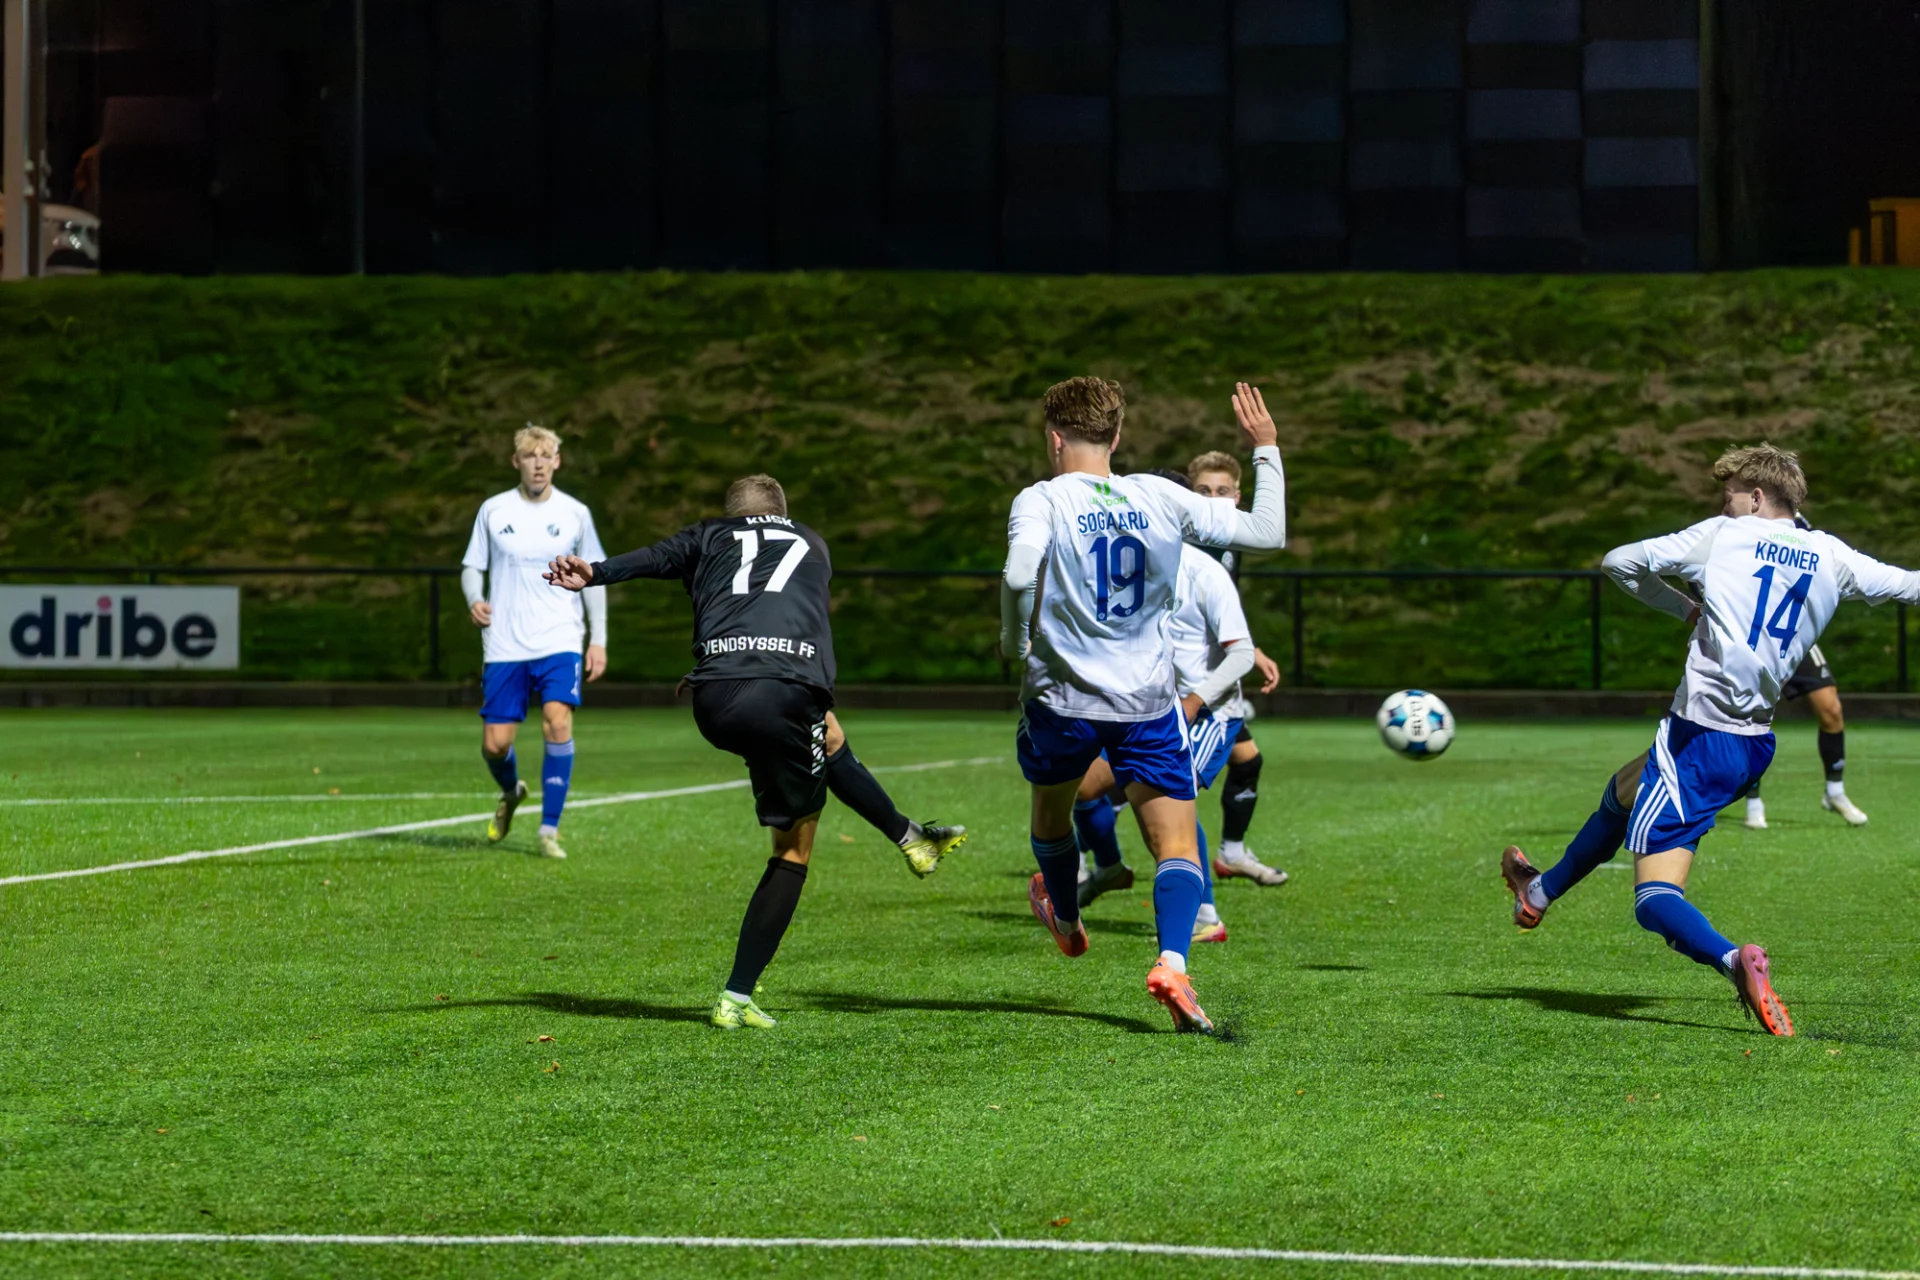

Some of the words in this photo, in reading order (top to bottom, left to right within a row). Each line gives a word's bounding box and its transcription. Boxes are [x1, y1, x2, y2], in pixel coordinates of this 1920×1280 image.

[745, 514, 795, 528] KUSK
[1077, 511, 1150, 533] SØGAARD
[732, 528, 810, 594] 17
[1088, 535, 1146, 622] 19
[1754, 541, 1820, 572] KRONER
[9, 594, 218, 659] dribe
[1747, 564, 1814, 659] 14
[701, 635, 795, 656] VENDSYSSEL
[798, 641, 816, 658] FF
